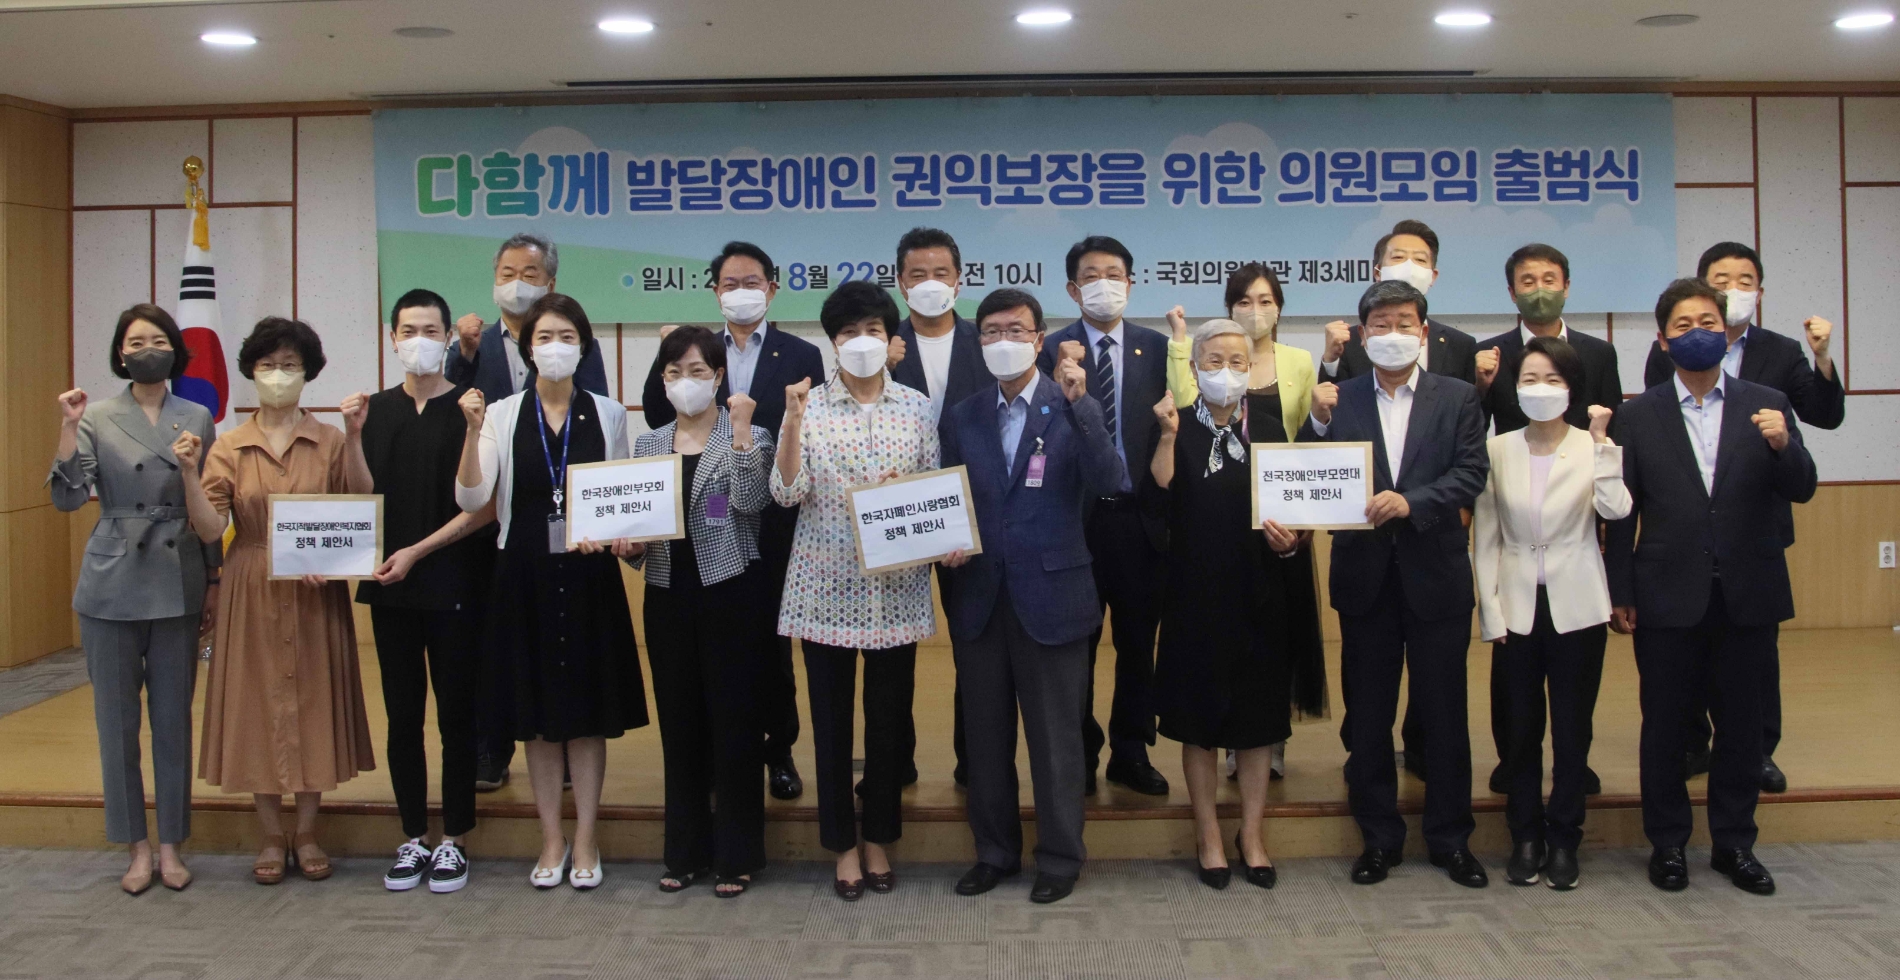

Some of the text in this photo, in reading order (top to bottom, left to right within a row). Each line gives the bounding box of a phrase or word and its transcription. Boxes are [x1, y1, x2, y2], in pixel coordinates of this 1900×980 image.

[416, 148, 1640, 218] 다함께 발달장애인 권익보장을 위한 의원모임 출범식
[642, 267, 684, 291] 일시
[788, 262, 829, 291] 8월
[837, 261, 896, 288] 22일
[959, 262, 985, 287] 전
[994, 262, 1042, 287] 10시
[1156, 260, 1292, 286] 국회의관
[1298, 259, 1377, 284] 제3세미
[1263, 468, 1360, 482] 전국장애인부모연대
[581, 480, 665, 501] 한국장애인부모회
[1282, 488, 1343, 501] 정책 제안서
[595, 500, 652, 518] 정책 제안서
[861, 494, 960, 525] 한국자폐인사랑협회
[884, 517, 946, 541] 정책 제안서
[295, 536, 354, 549] 정책 제안서
